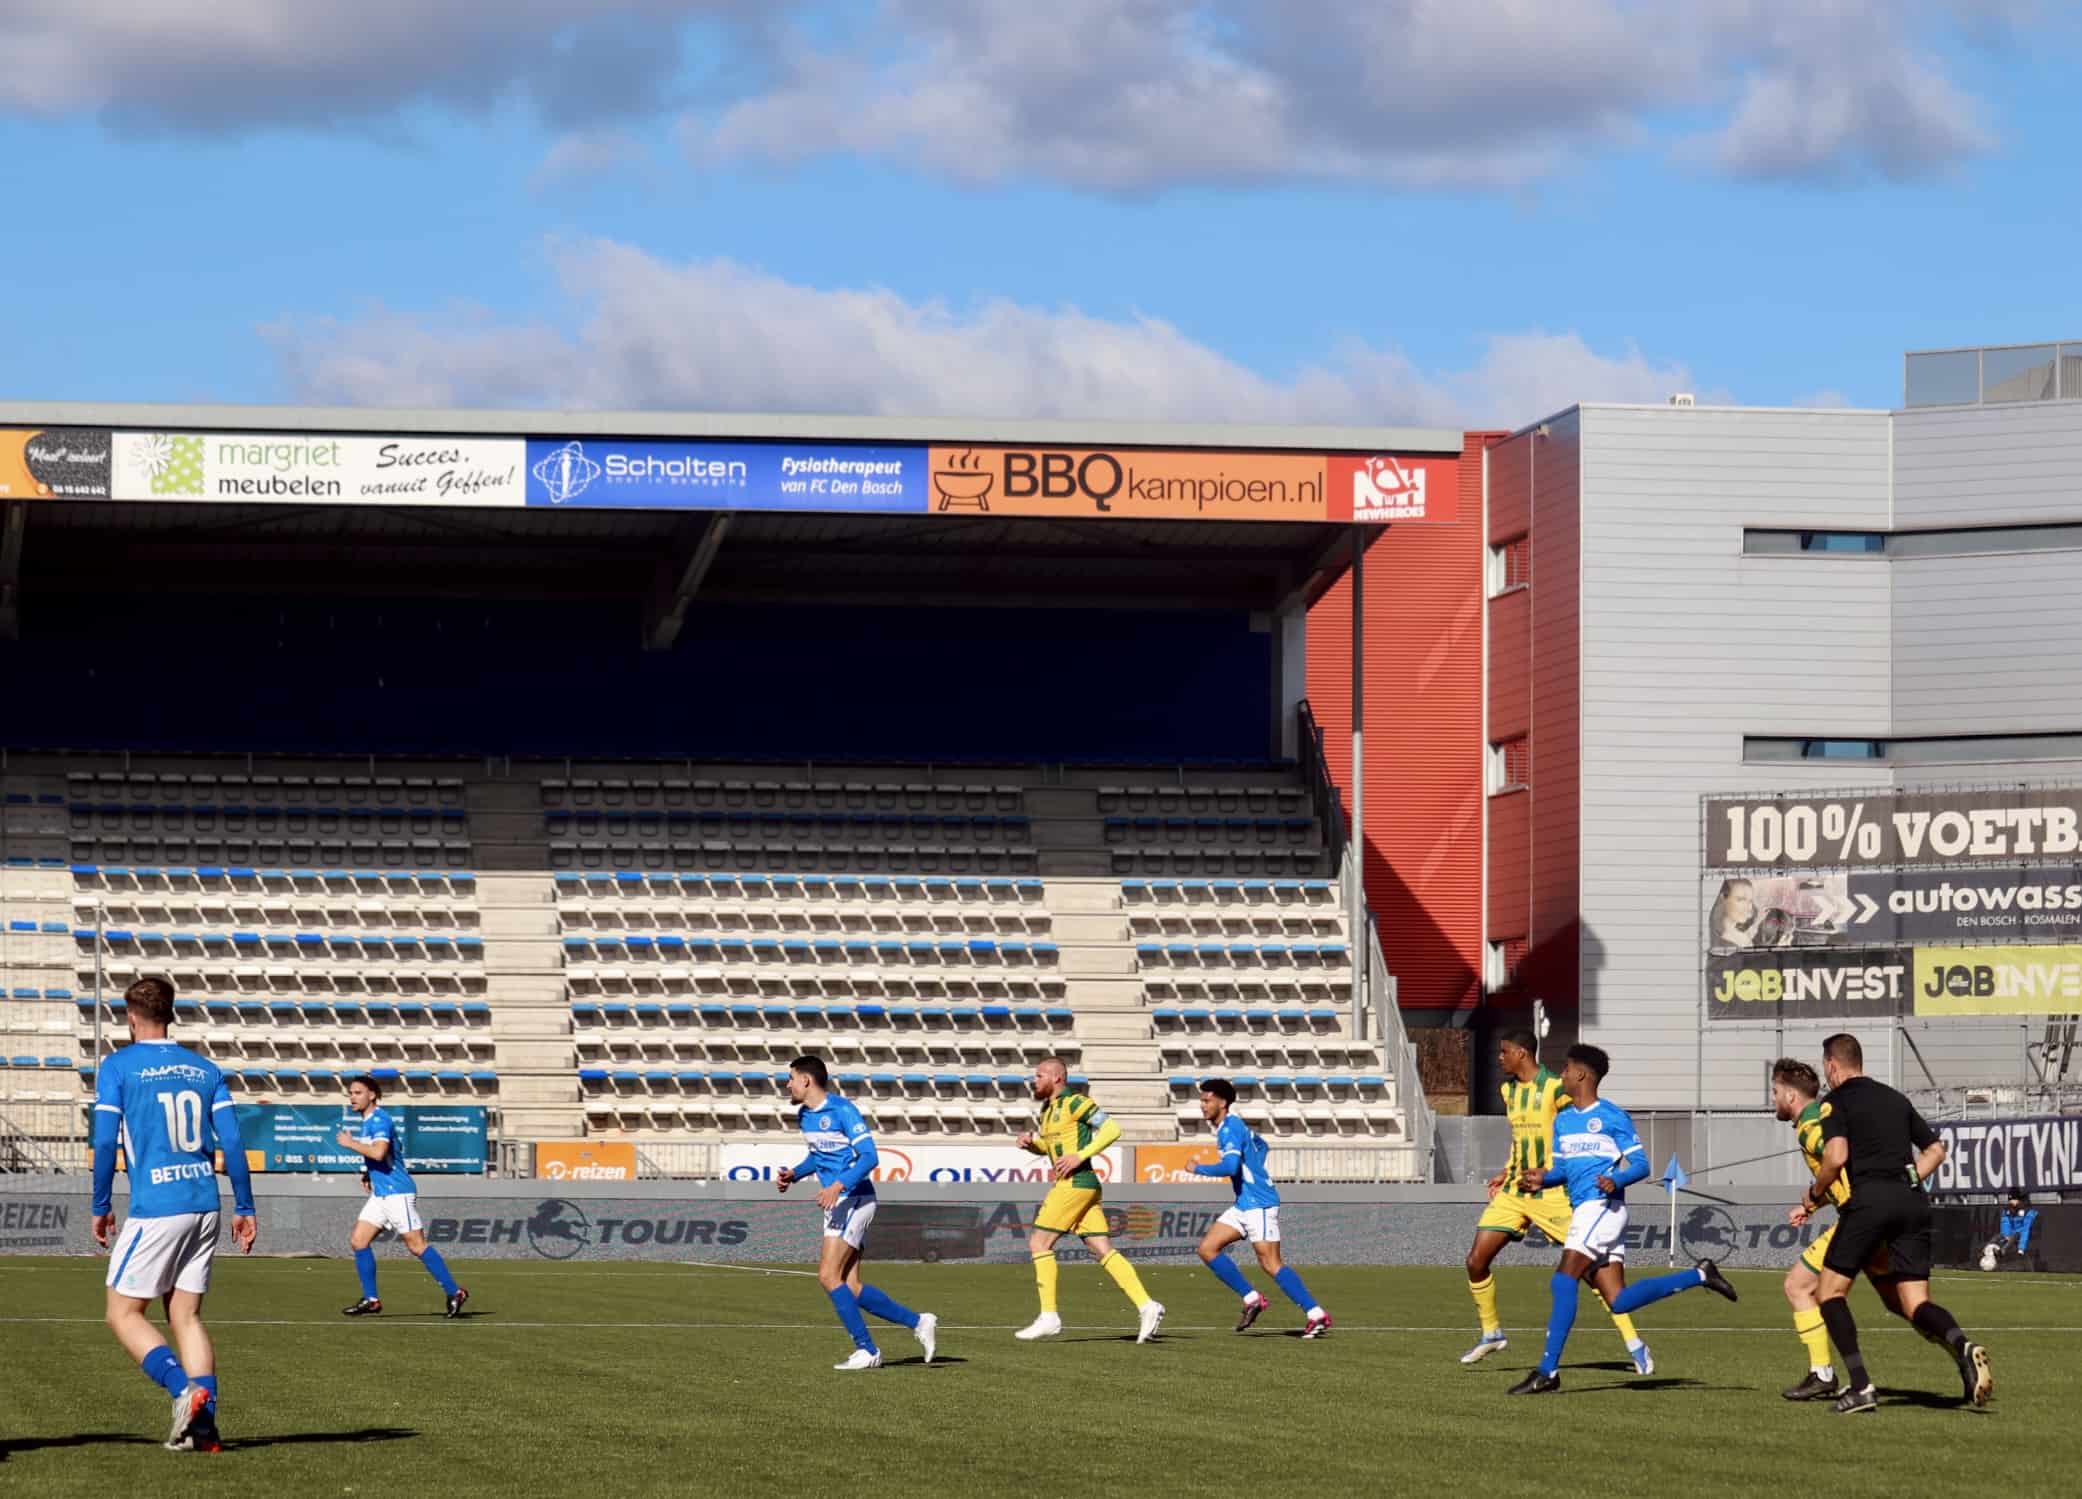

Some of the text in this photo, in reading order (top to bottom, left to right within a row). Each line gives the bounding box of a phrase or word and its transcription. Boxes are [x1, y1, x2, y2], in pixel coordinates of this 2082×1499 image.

[219, 440, 341, 472] margriet
[606, 454, 747, 477] Scholten
[782, 457, 902, 478] Fysiotherapeut
[219, 474, 341, 496] meubelen
[360, 465, 515, 496] vanuit Geffen!
[781, 479, 902, 495] van FC Den Bosch
[1003, 453, 1323, 511] BBQ kampioen.nl
[1725, 803, 2082, 862] 100% VOETB
[1956, 917, 1978, 927] DEN
[1980, 915, 2016, 926] BOSCH
[2024, 912, 2081, 925] ROSMALEN
[157, 1090, 202, 1152] 10
[338, 1154, 365, 1163] BOSC
[545, 1160, 627, 1180] D-reizen
[0, 1203, 69, 1230] EIZEN
[597, 1219, 749, 1245] TOURS
